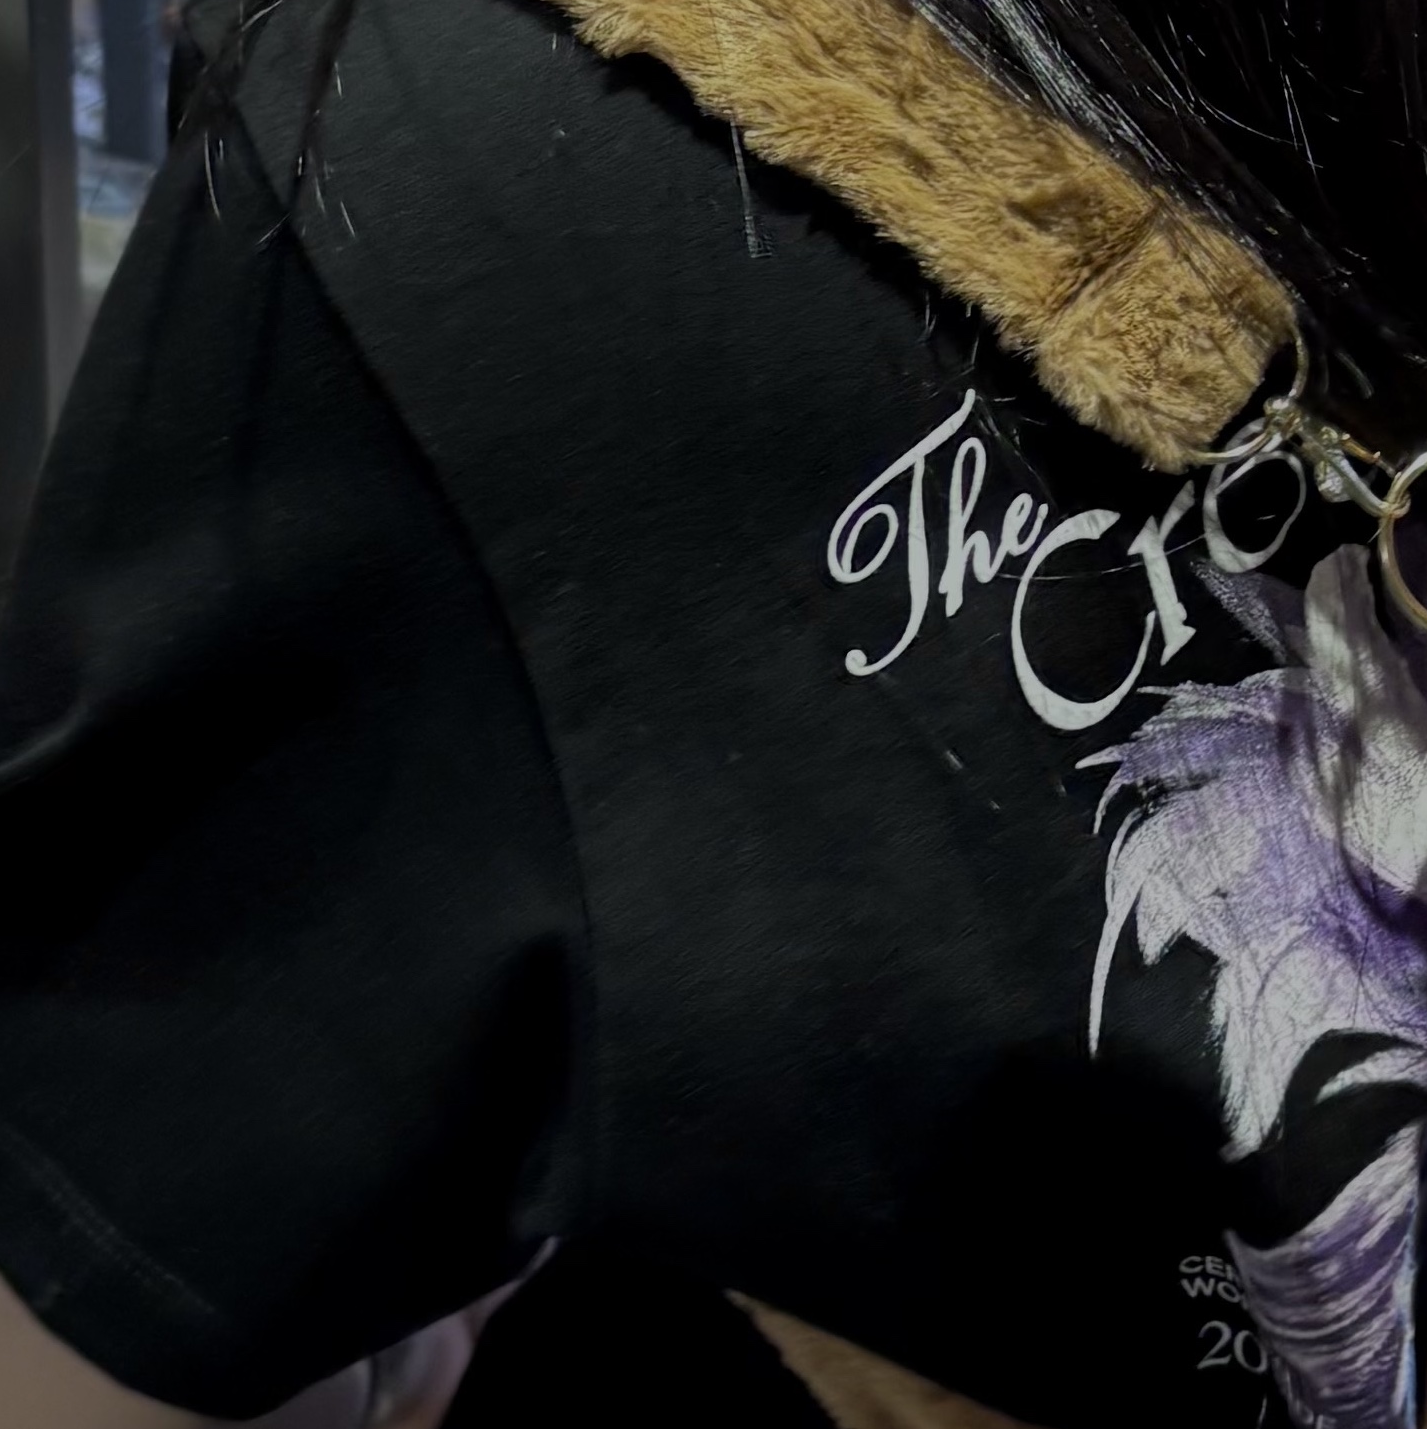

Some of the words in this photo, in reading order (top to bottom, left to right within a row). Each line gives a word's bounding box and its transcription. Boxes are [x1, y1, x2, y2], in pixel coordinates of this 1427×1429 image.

[826, 387, 1048, 677] The
[1010, 417, 1307, 732] Cro
[1196, 1319, 1269, 1375] 20
